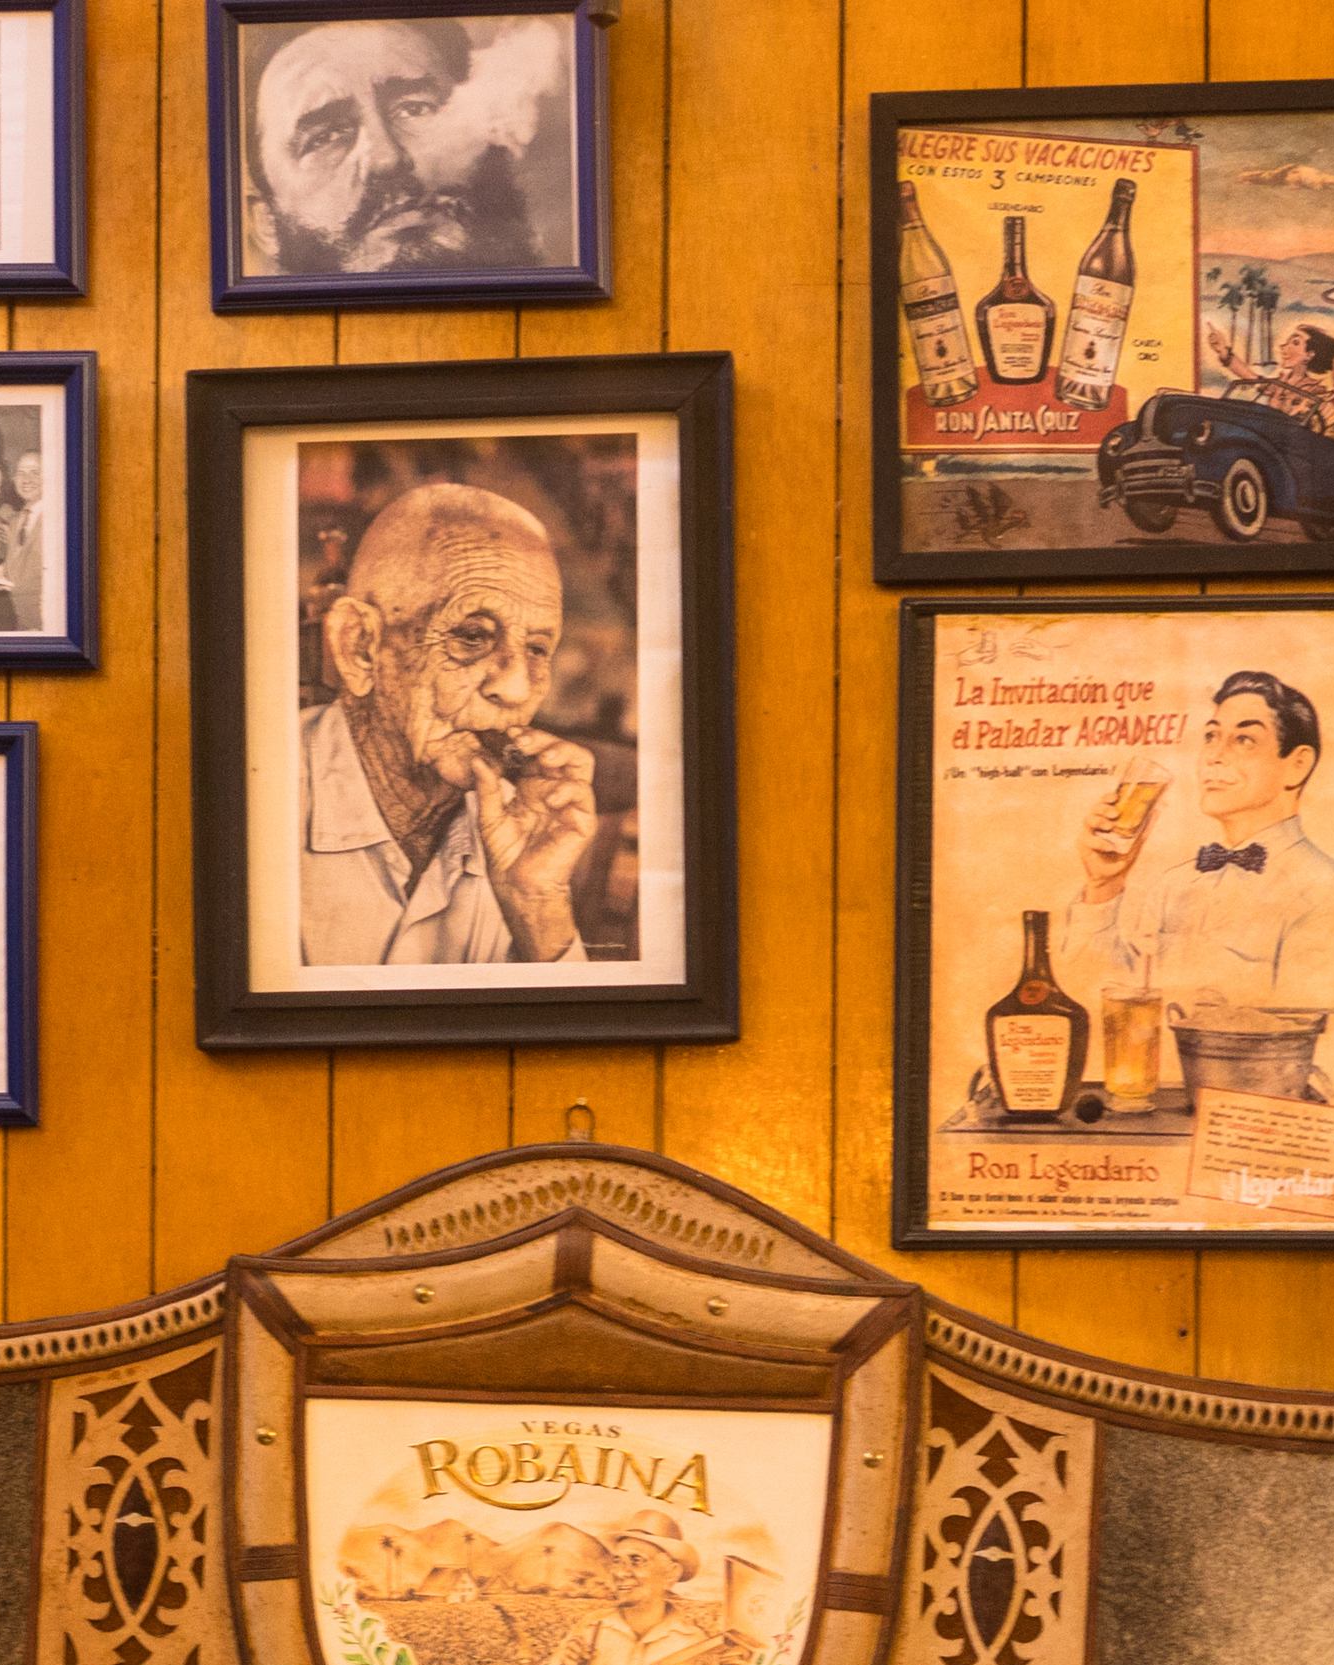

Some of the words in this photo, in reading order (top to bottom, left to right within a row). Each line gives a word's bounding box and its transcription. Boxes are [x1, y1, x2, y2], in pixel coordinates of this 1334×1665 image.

[981, 138, 1017, 163] SUS
[1024, 142, 1157, 173] VACACIONES
[907, 164, 936, 176] CON
[942, 167, 982, 179] ESTOS
[990, 170, 1007, 189] 3
[1016, 171, 1097, 187] CAMPEONES
[935, 411, 974, 432] RON
[972, 404, 1034, 441] SANTA
[1035, 404, 1081, 436] CRUZ
[954, 677, 984, 707] La
[990, 675, 1108, 706] Invitación
[1113, 680, 1155, 709] que
[952, 721, 969, 750] el
[975, 718, 1071, 750] Paladar
[1075, 713, 1189, 747] AGRADECE!
[968, 1152, 1020, 1180] Ron
[1029, 1153, 1160, 1192] Legendario
[521, 1421, 622, 1439] VEGAS
[408, 1438, 714, 1517] ROBAINA
